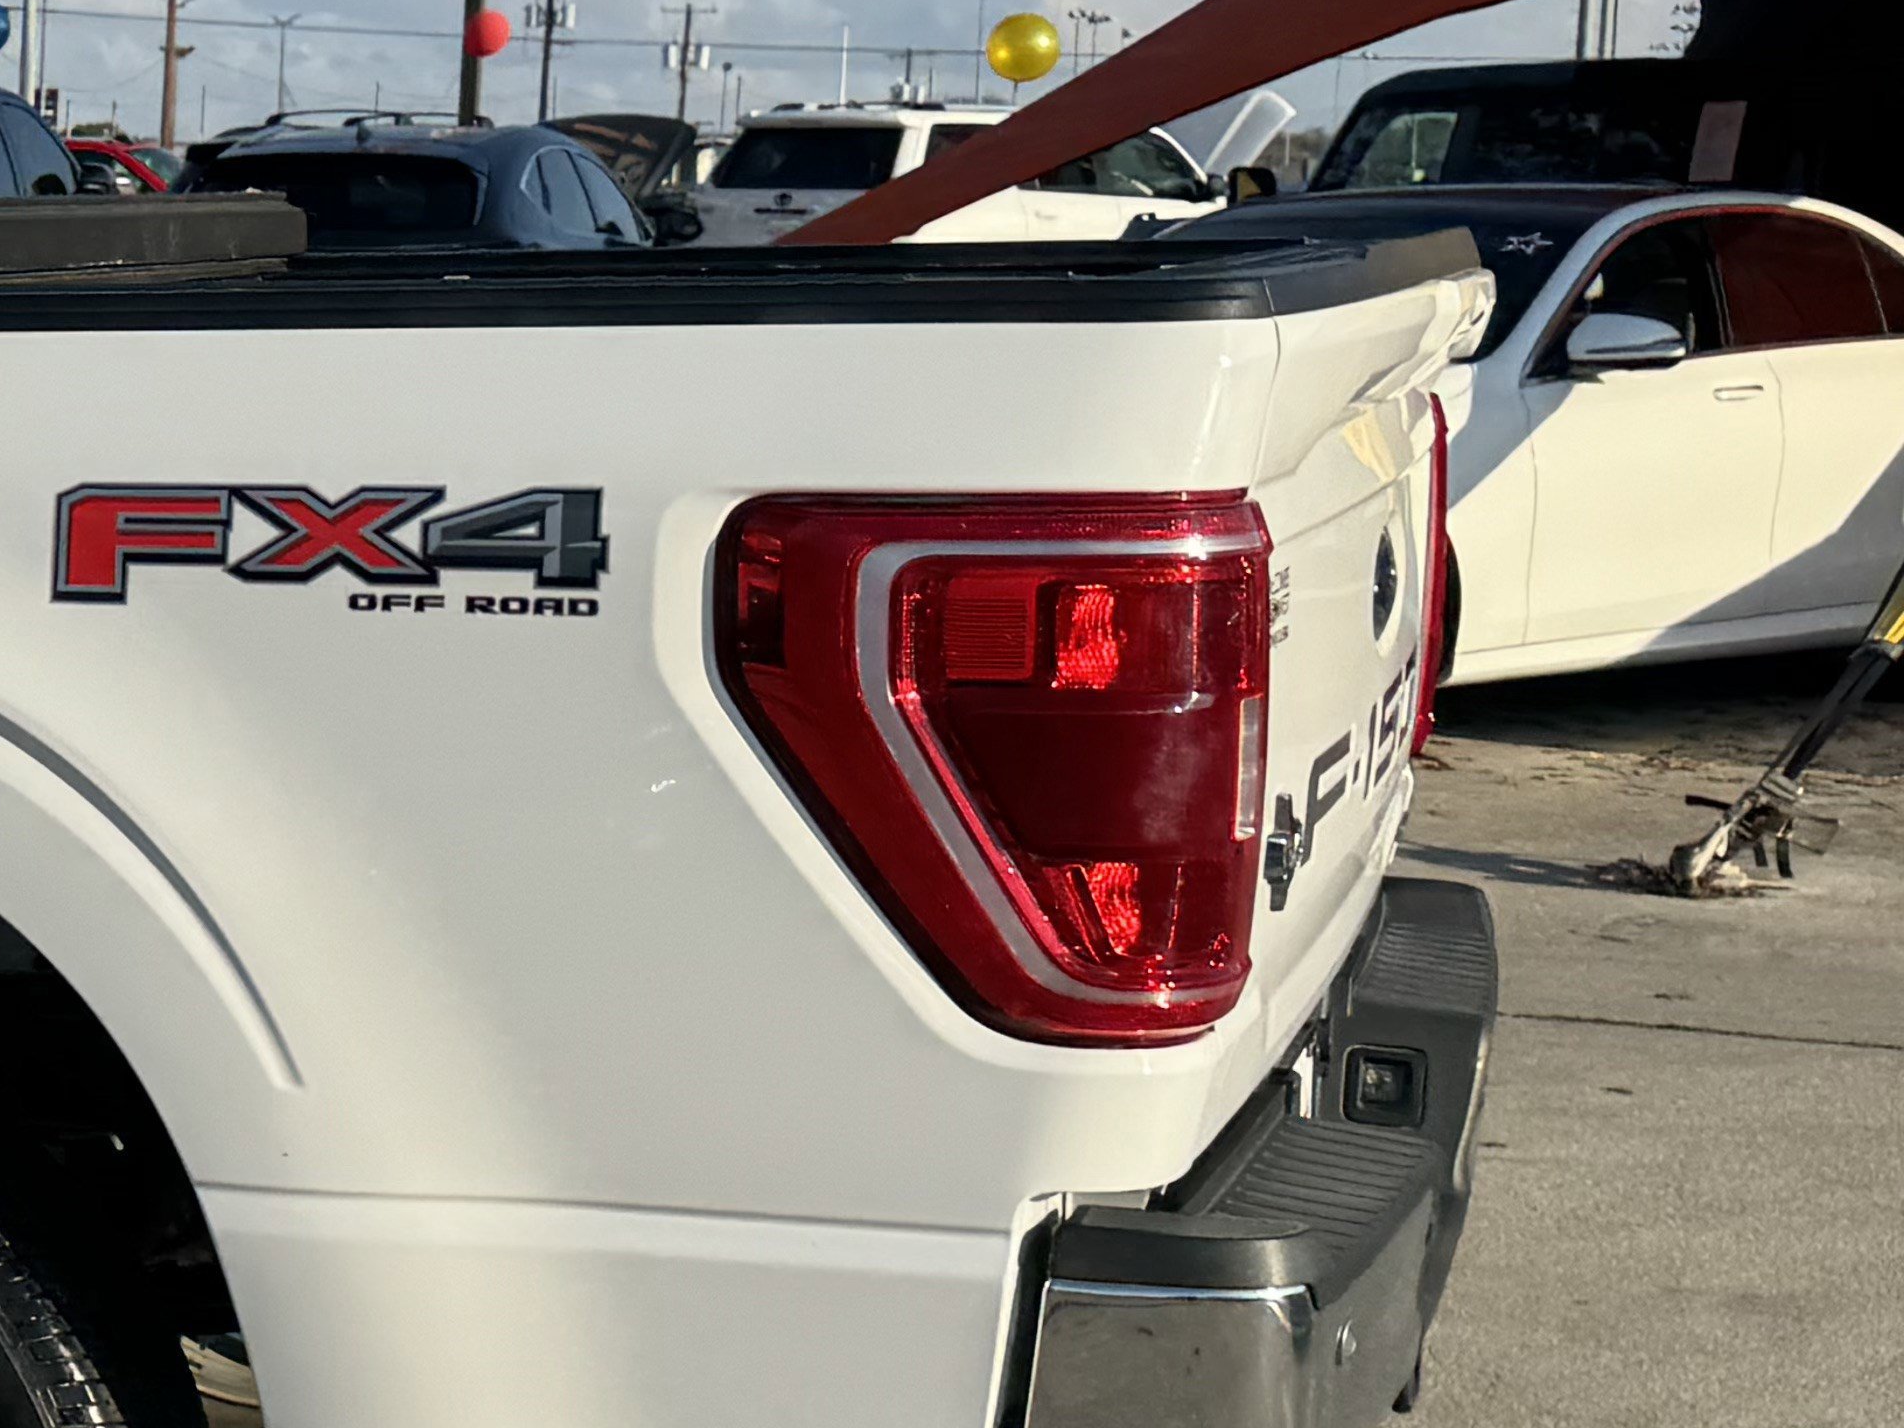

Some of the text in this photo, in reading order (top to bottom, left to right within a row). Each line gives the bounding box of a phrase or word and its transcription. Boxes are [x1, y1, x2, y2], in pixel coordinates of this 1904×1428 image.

[49, 482, 610, 604] FX4
[348, 592, 600, 617] OFF ROAD
